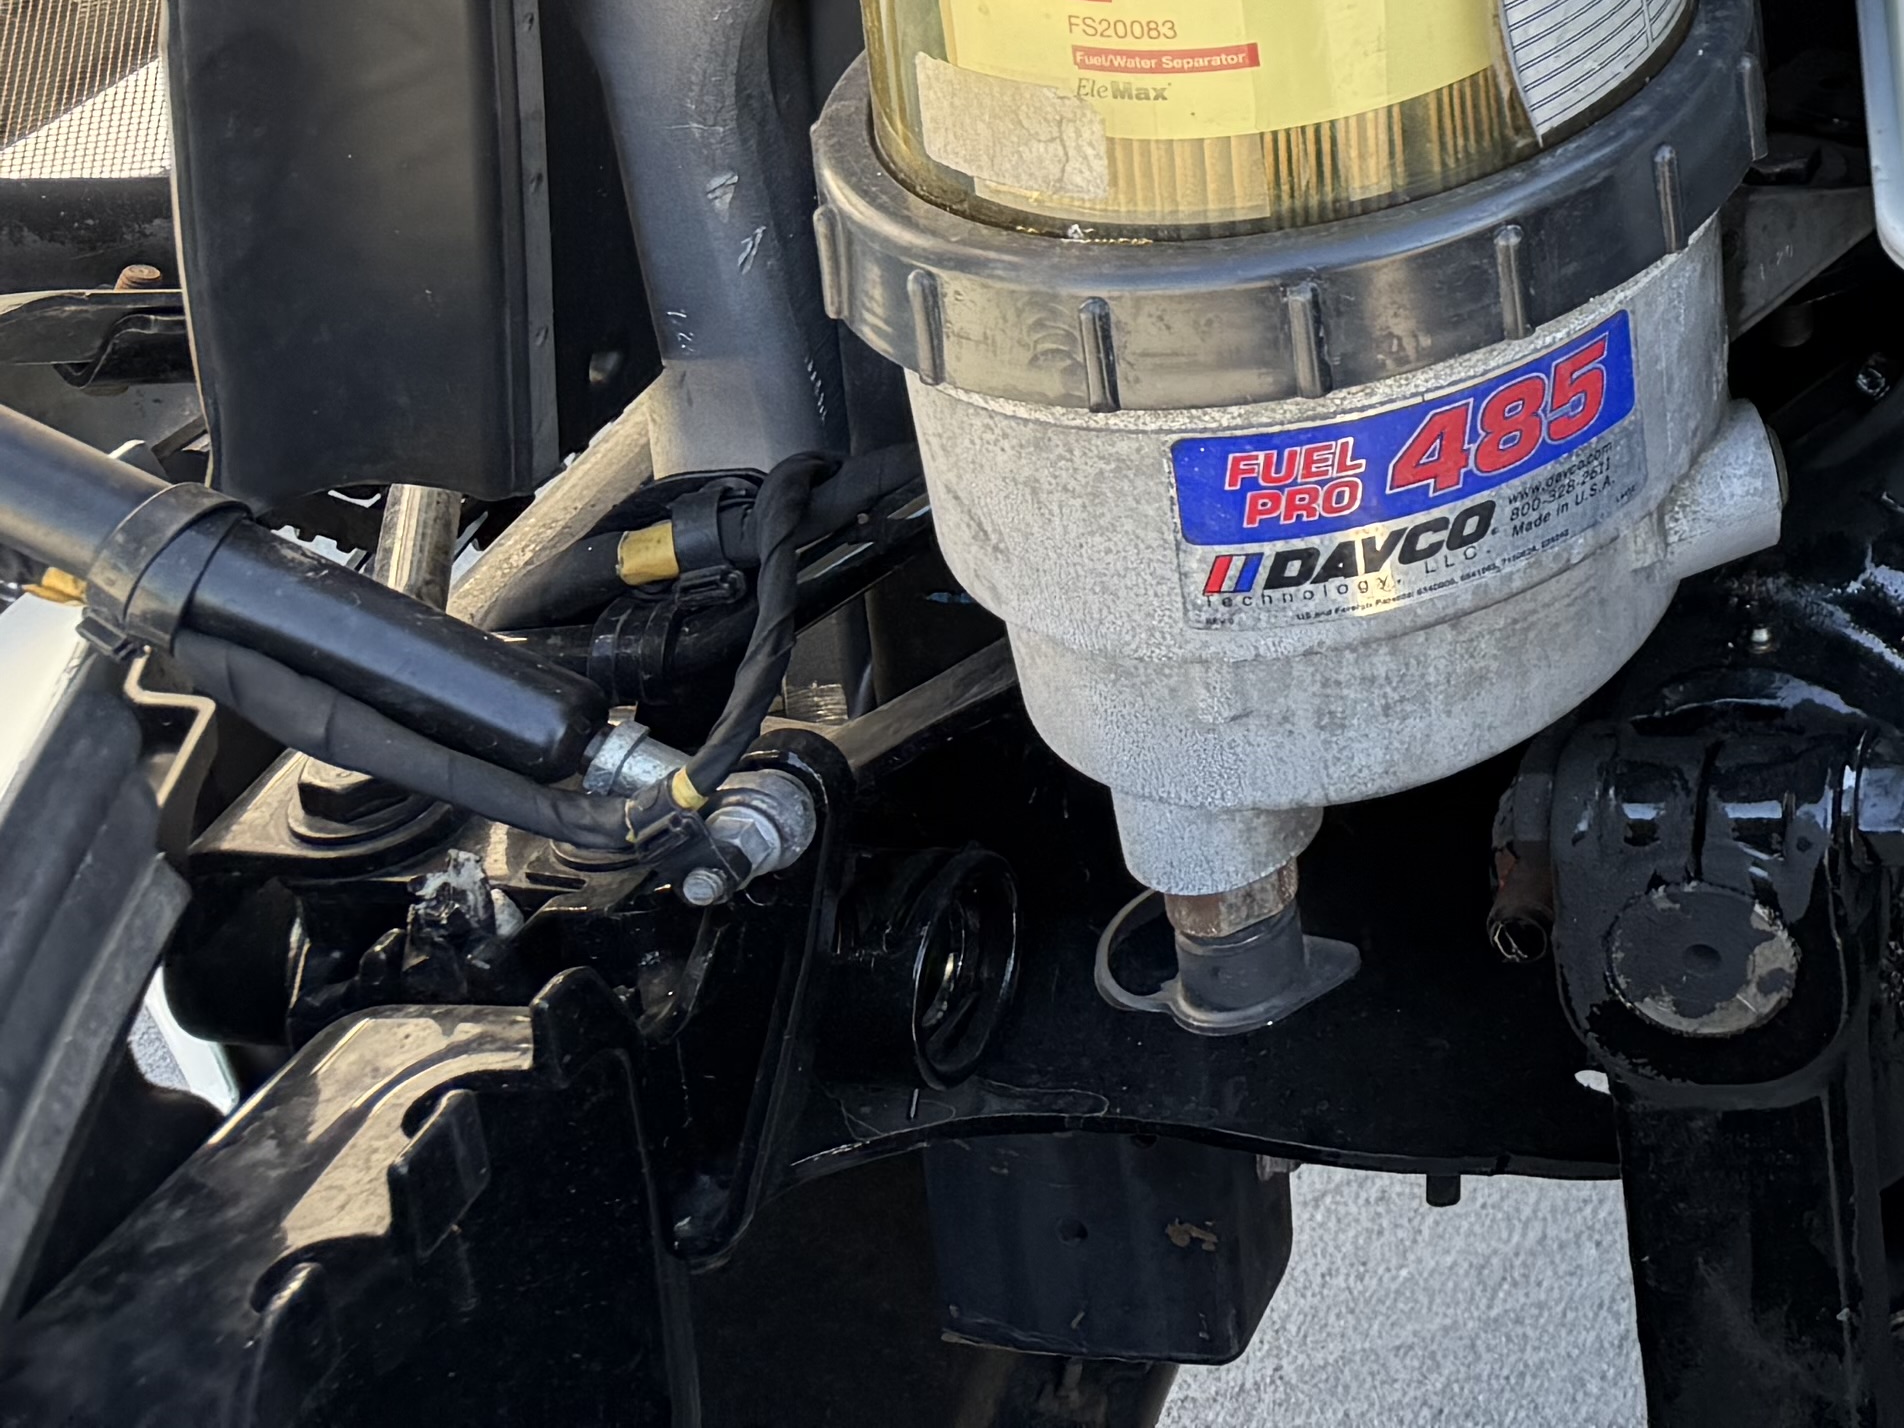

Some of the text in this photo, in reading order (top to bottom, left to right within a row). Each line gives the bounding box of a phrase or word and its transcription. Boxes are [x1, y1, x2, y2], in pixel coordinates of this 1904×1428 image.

[1067, 14, 1178, 40] FS20083
[1075, 50, 1247, 71] Fuel/Water Separator
[1076, 77, 1168, 101] EleMax
[1385, 331, 1609, 498] 485
[1224, 436, 1367, 491] FUEL
[1507, 440, 1613, 506] www.davco.com
[1243, 476, 1363, 529] PRO
[1511, 510, 1551, 537] Made
[1556, 502, 1569, 517] in
[1574, 478, 1616, 507] U.S.A.
[1263, 499, 1497, 591] DAVCO
